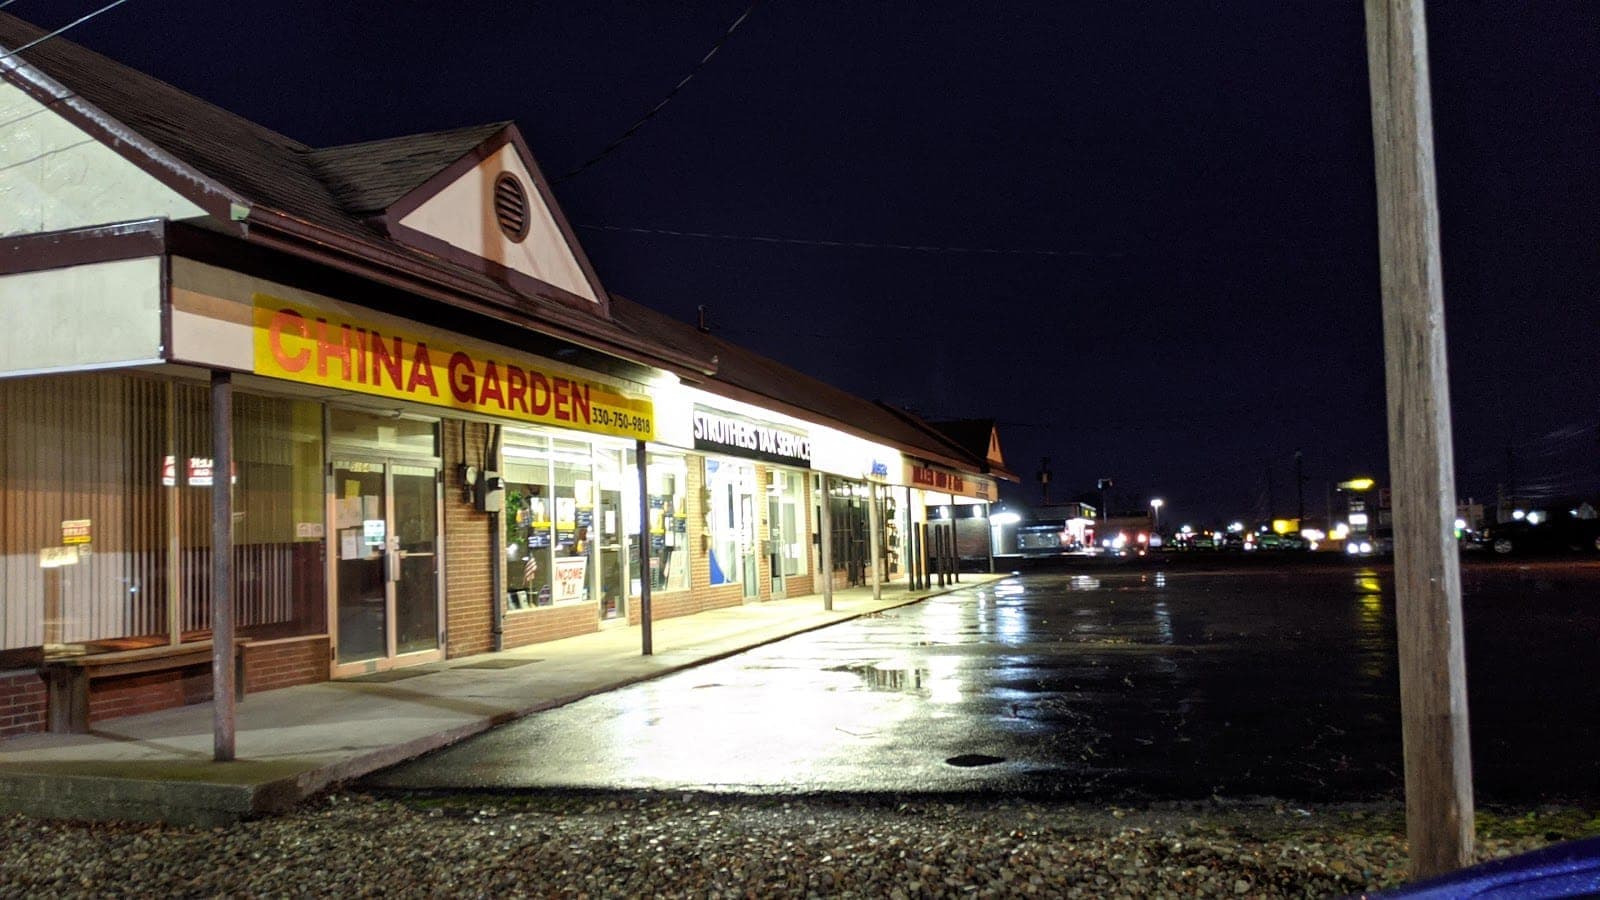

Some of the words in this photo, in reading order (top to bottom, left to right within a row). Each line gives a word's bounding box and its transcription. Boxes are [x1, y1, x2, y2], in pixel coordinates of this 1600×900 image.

[269, 308, 439, 398] CHINA
[448, 351, 591, 425] GARDEN
[592, 406, 651, 433] 330-750-9818
[694, 412, 758, 450] STRUTHERS
[757, 427, 777, 455] TAX
[776, 431, 811, 461] SERVICE
[555, 567, 584, 581] INCOME
[561, 581, 577, 596] TAX
